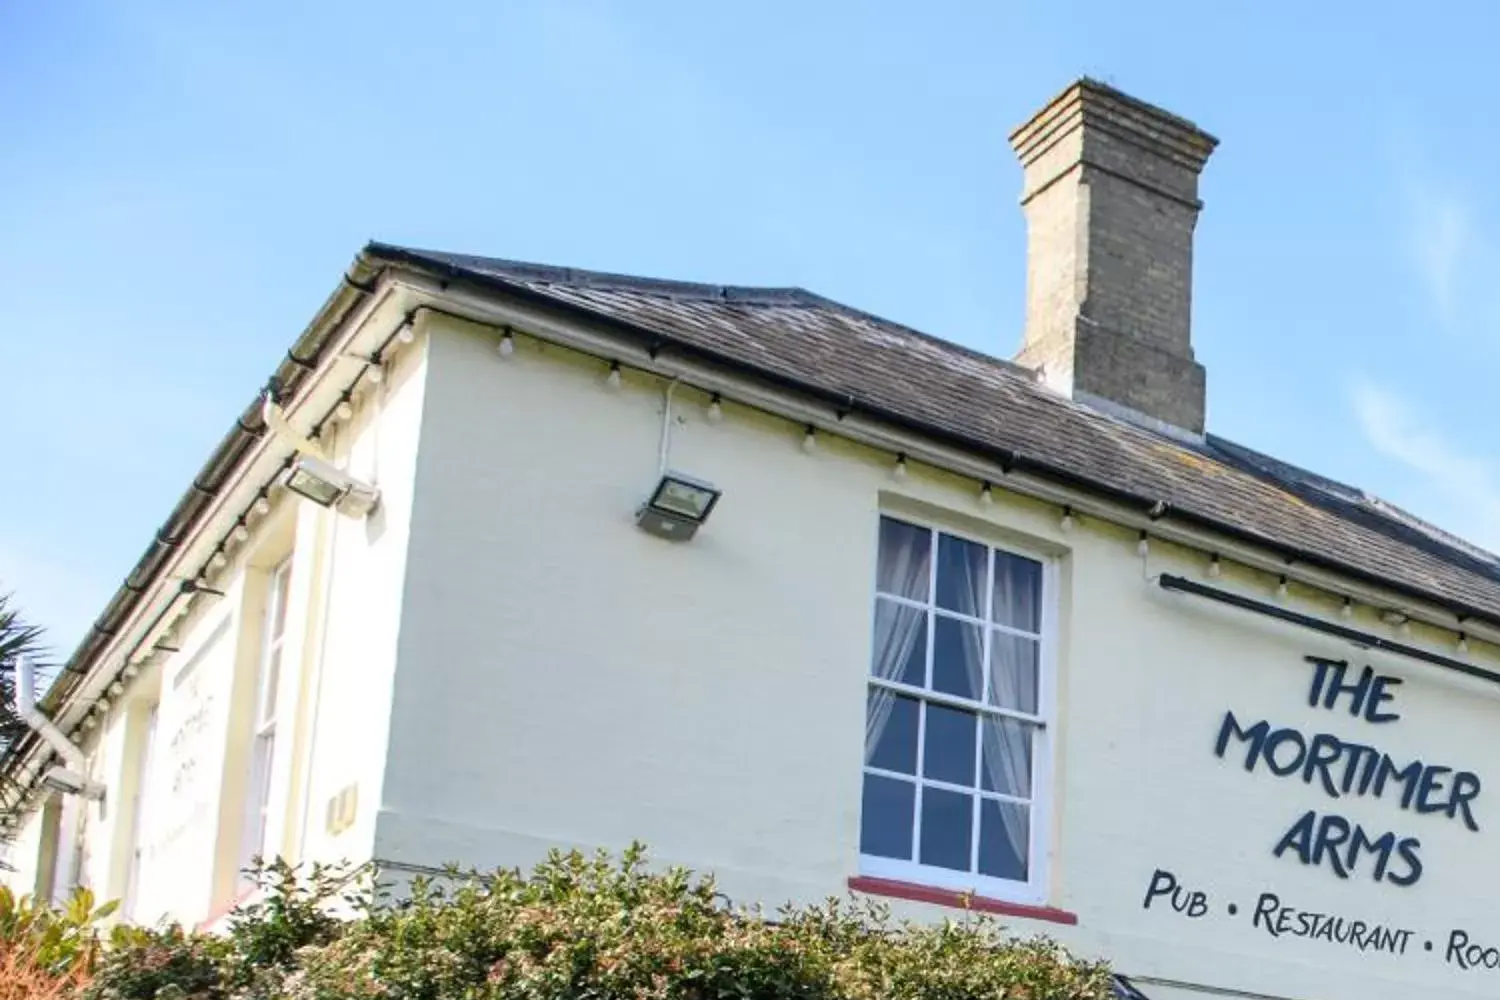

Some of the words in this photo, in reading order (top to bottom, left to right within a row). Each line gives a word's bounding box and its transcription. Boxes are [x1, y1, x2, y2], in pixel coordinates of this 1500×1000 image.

[1304, 655, 1404, 723] THE
[1213, 710, 1481, 832] MORTIMER
[1273, 810, 1423, 886] ARMS
